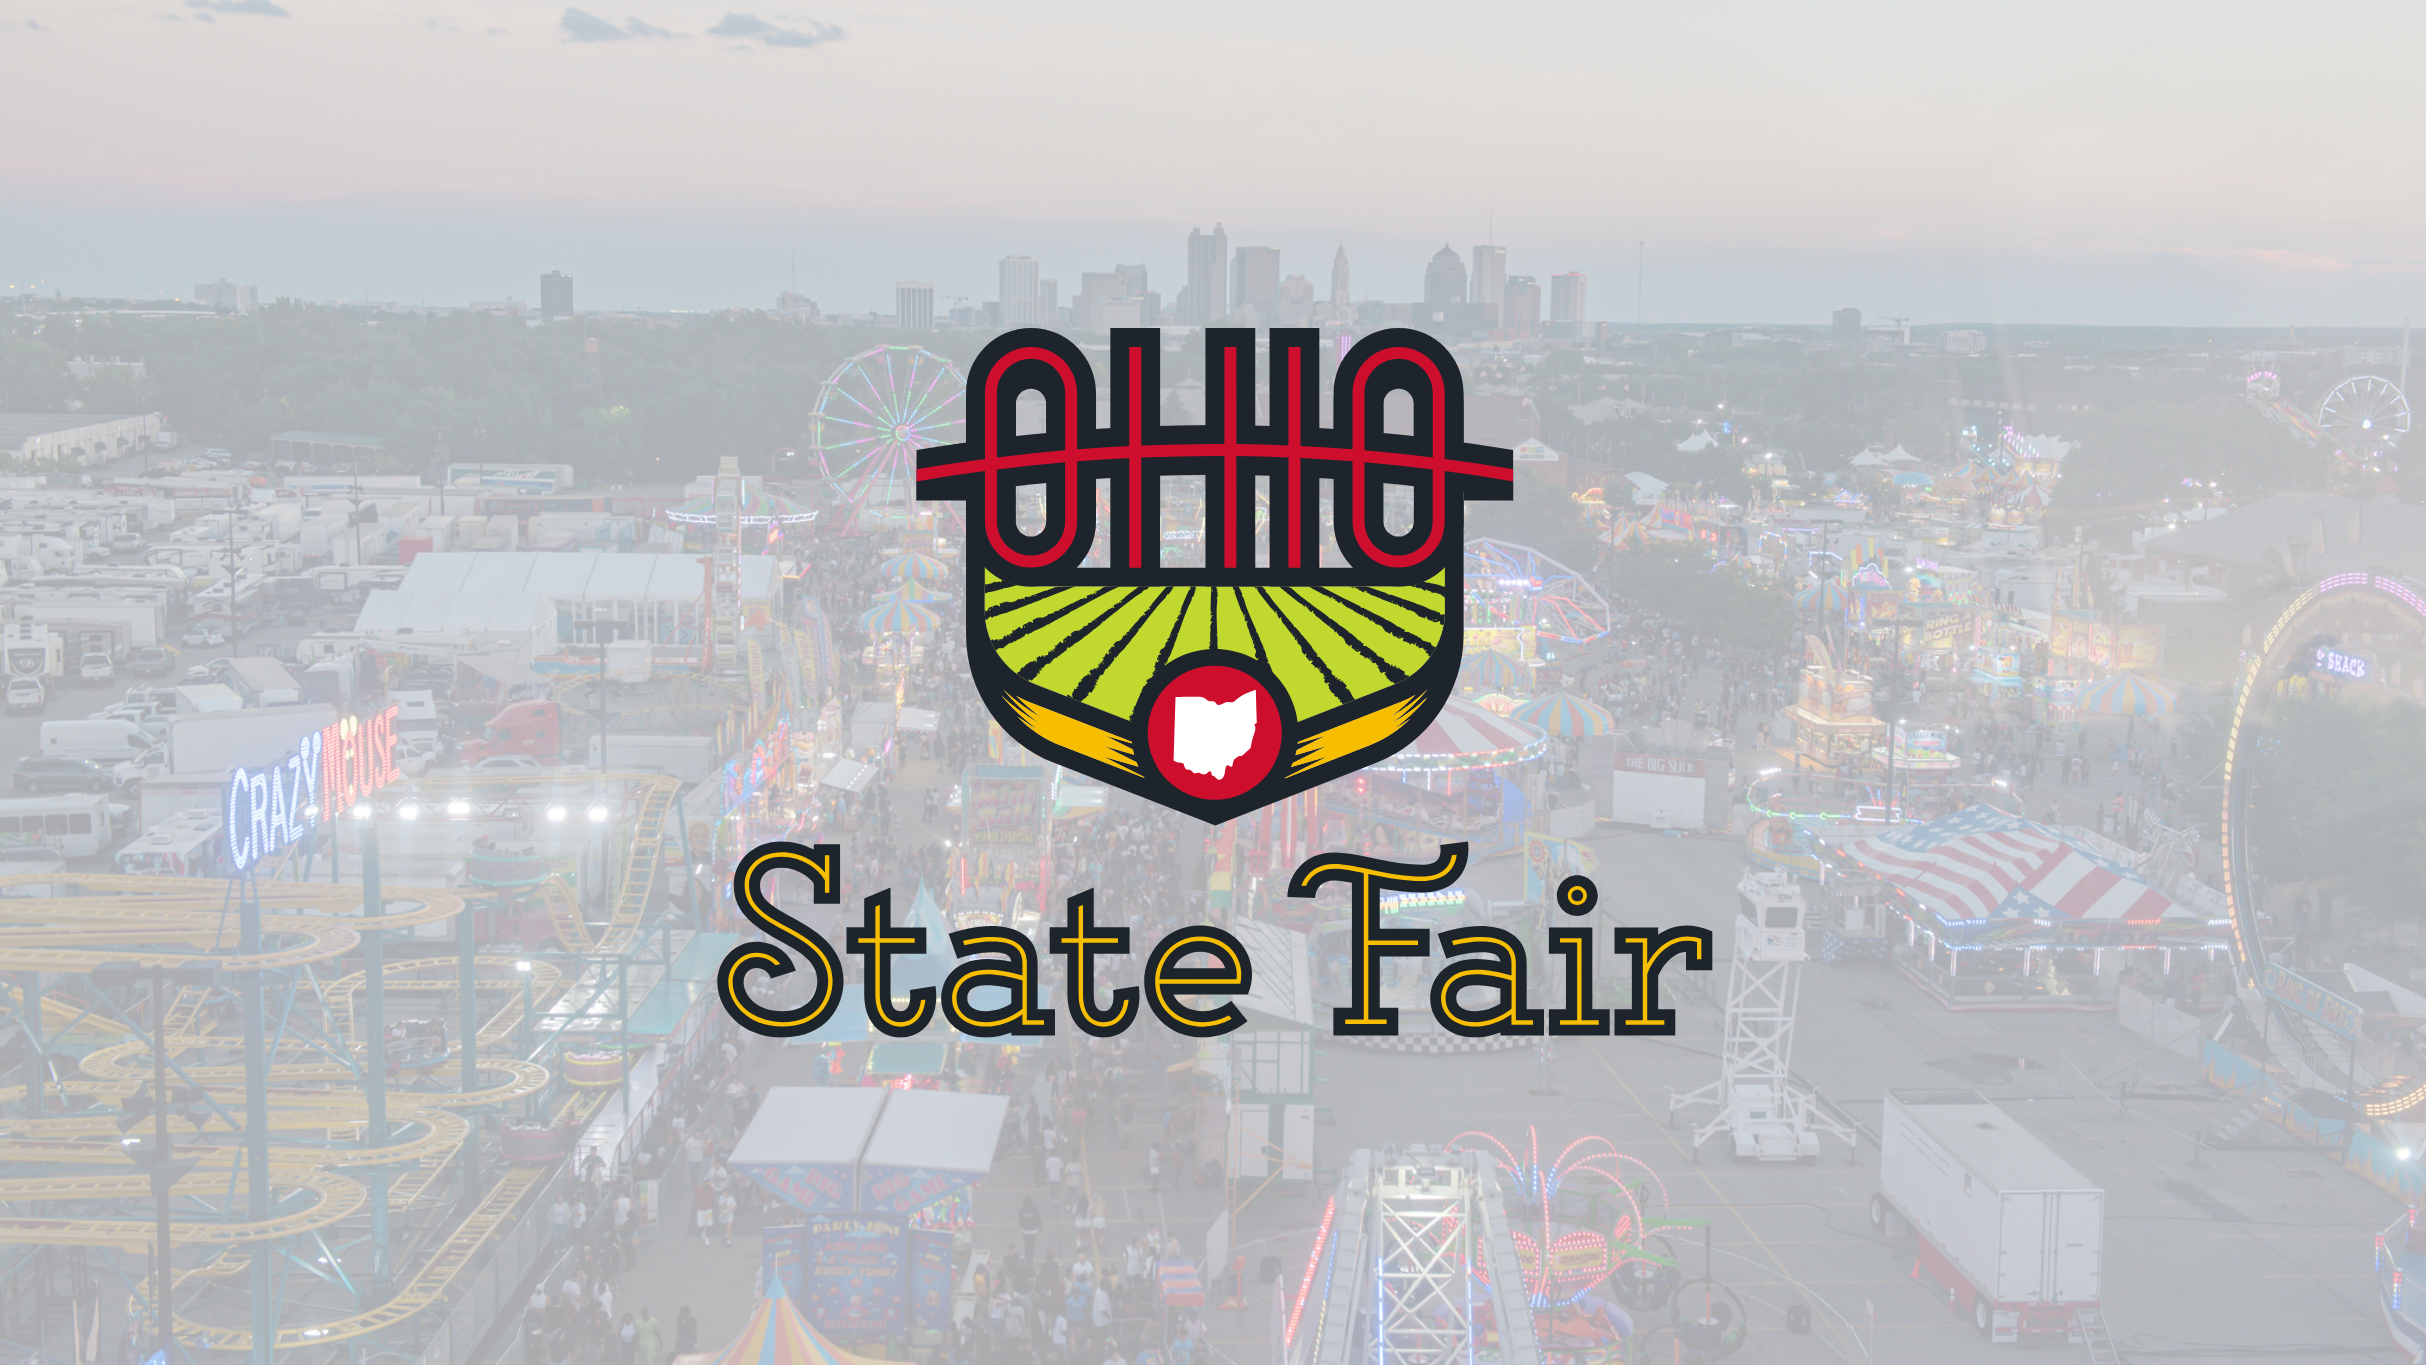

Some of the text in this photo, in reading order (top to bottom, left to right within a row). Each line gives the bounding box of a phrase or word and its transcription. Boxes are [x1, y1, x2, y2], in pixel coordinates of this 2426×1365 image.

[1924, 621, 1973, 643] BOTTLE
[1926, 611, 1972, 631] RING A
[2327, 651, 2366, 678] SHACK
[1625, 757, 1695, 773] THE BIG SLICE
[229, 705, 401, 870] CRAZY MOUSE
[2275, 970, 2348, 1028] RING OF FIRE
[763, 1167, 818, 1208] GAME
[805, 1167, 843, 1200] BIG
[870, 1171, 912, 1201] BIG
[893, 1173, 949, 1212] GAME
[813, 1220, 860, 1235] PARTY
[825, 1241, 887, 1252] KIDS WIN
